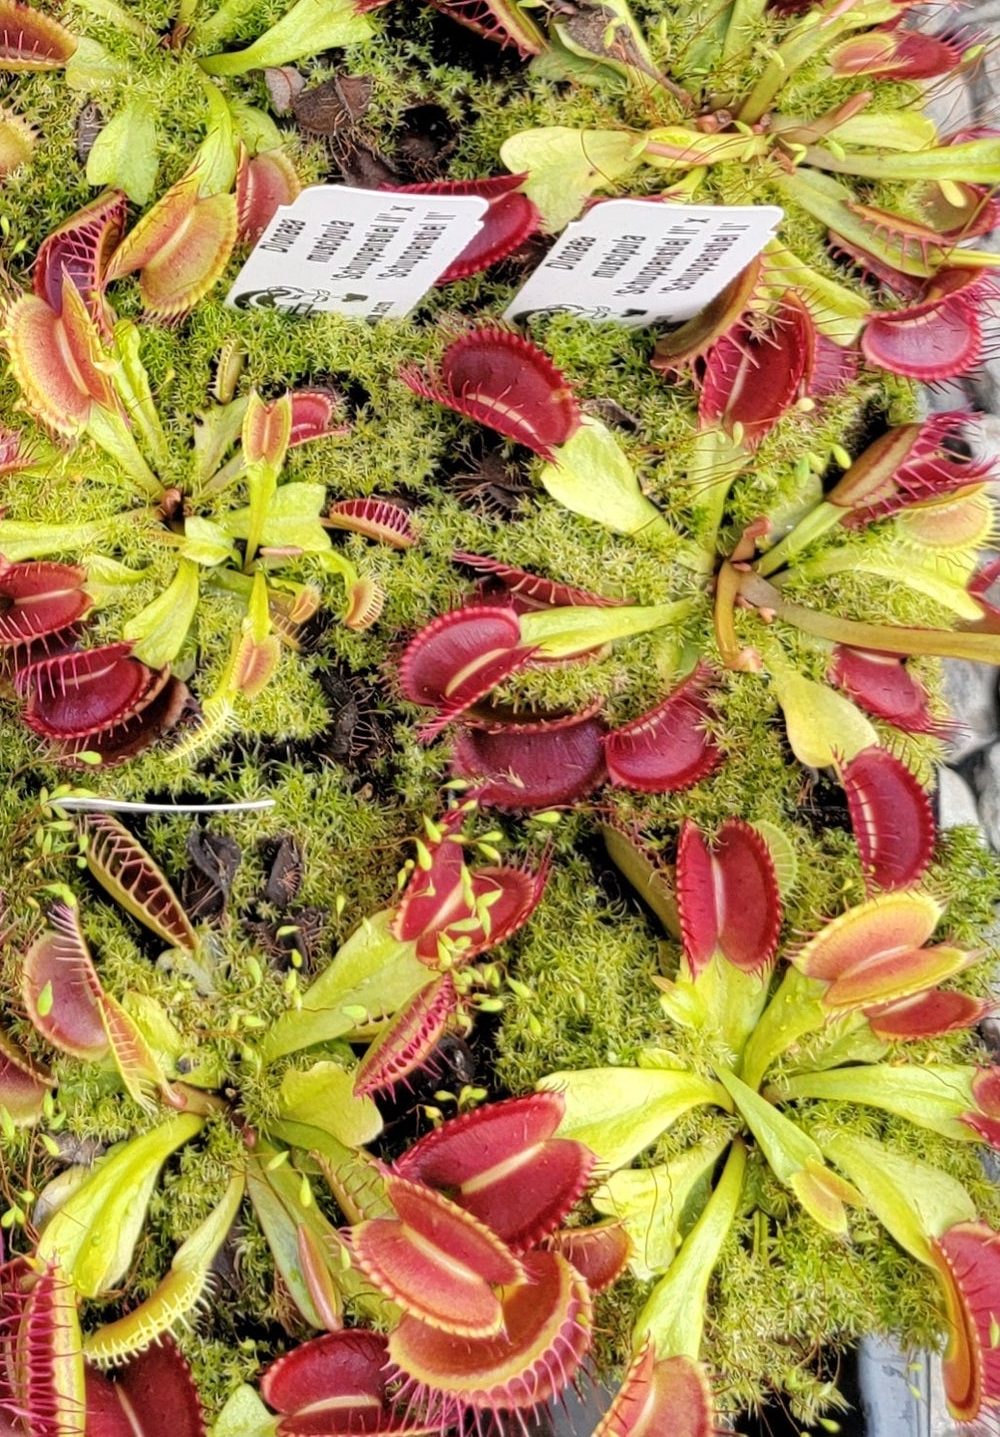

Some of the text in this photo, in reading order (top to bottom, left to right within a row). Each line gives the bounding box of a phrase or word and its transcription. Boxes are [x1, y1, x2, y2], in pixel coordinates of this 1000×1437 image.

[259, 218, 306, 253] Dionaea
[306, 220, 355, 263] muscipula
[545, 236, 597, 270] Dionaea
[591, 235, 646, 278] muscipula
